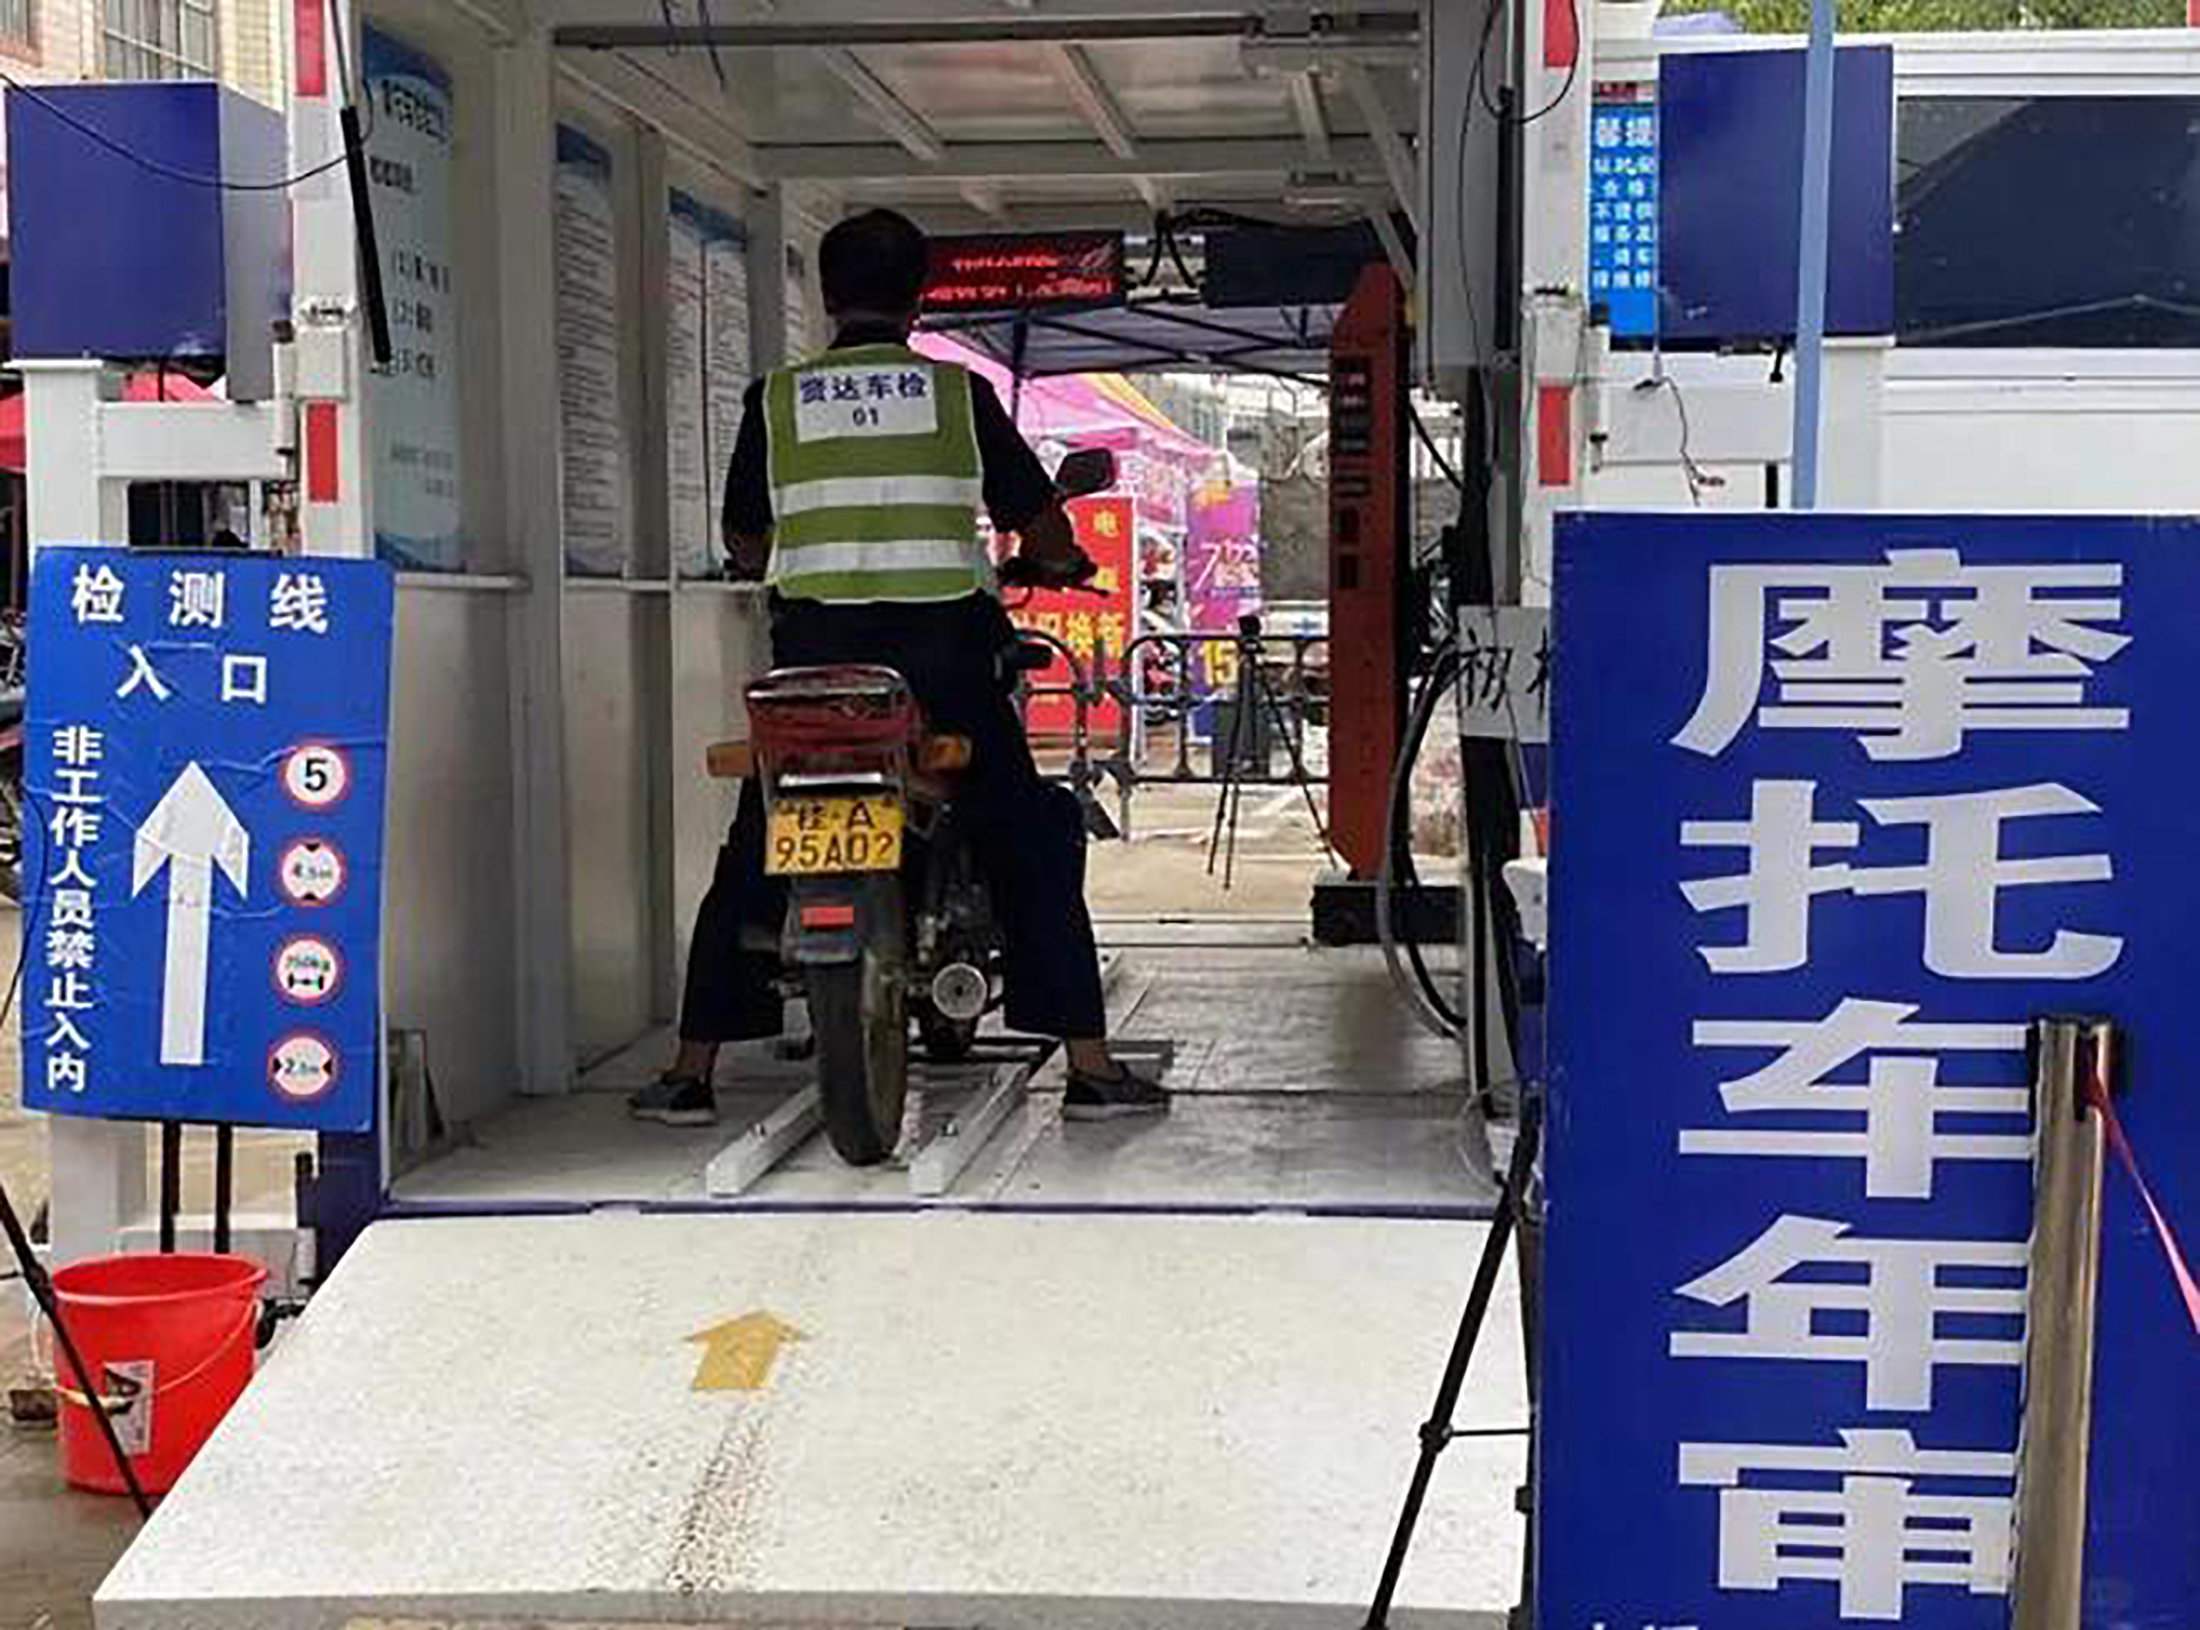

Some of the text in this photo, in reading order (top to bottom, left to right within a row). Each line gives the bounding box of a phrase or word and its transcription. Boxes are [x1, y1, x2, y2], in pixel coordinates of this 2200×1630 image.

[852, 406, 879, 427] 01
[71, 563, 329, 635] 检测线
[116, 644, 268, 704] 入口
[304, 757, 328, 792] 5
[44, 726, 105, 1093] 非工作人员禁止入内
[1668, 546, 2136, 1623] 摩托车年审
